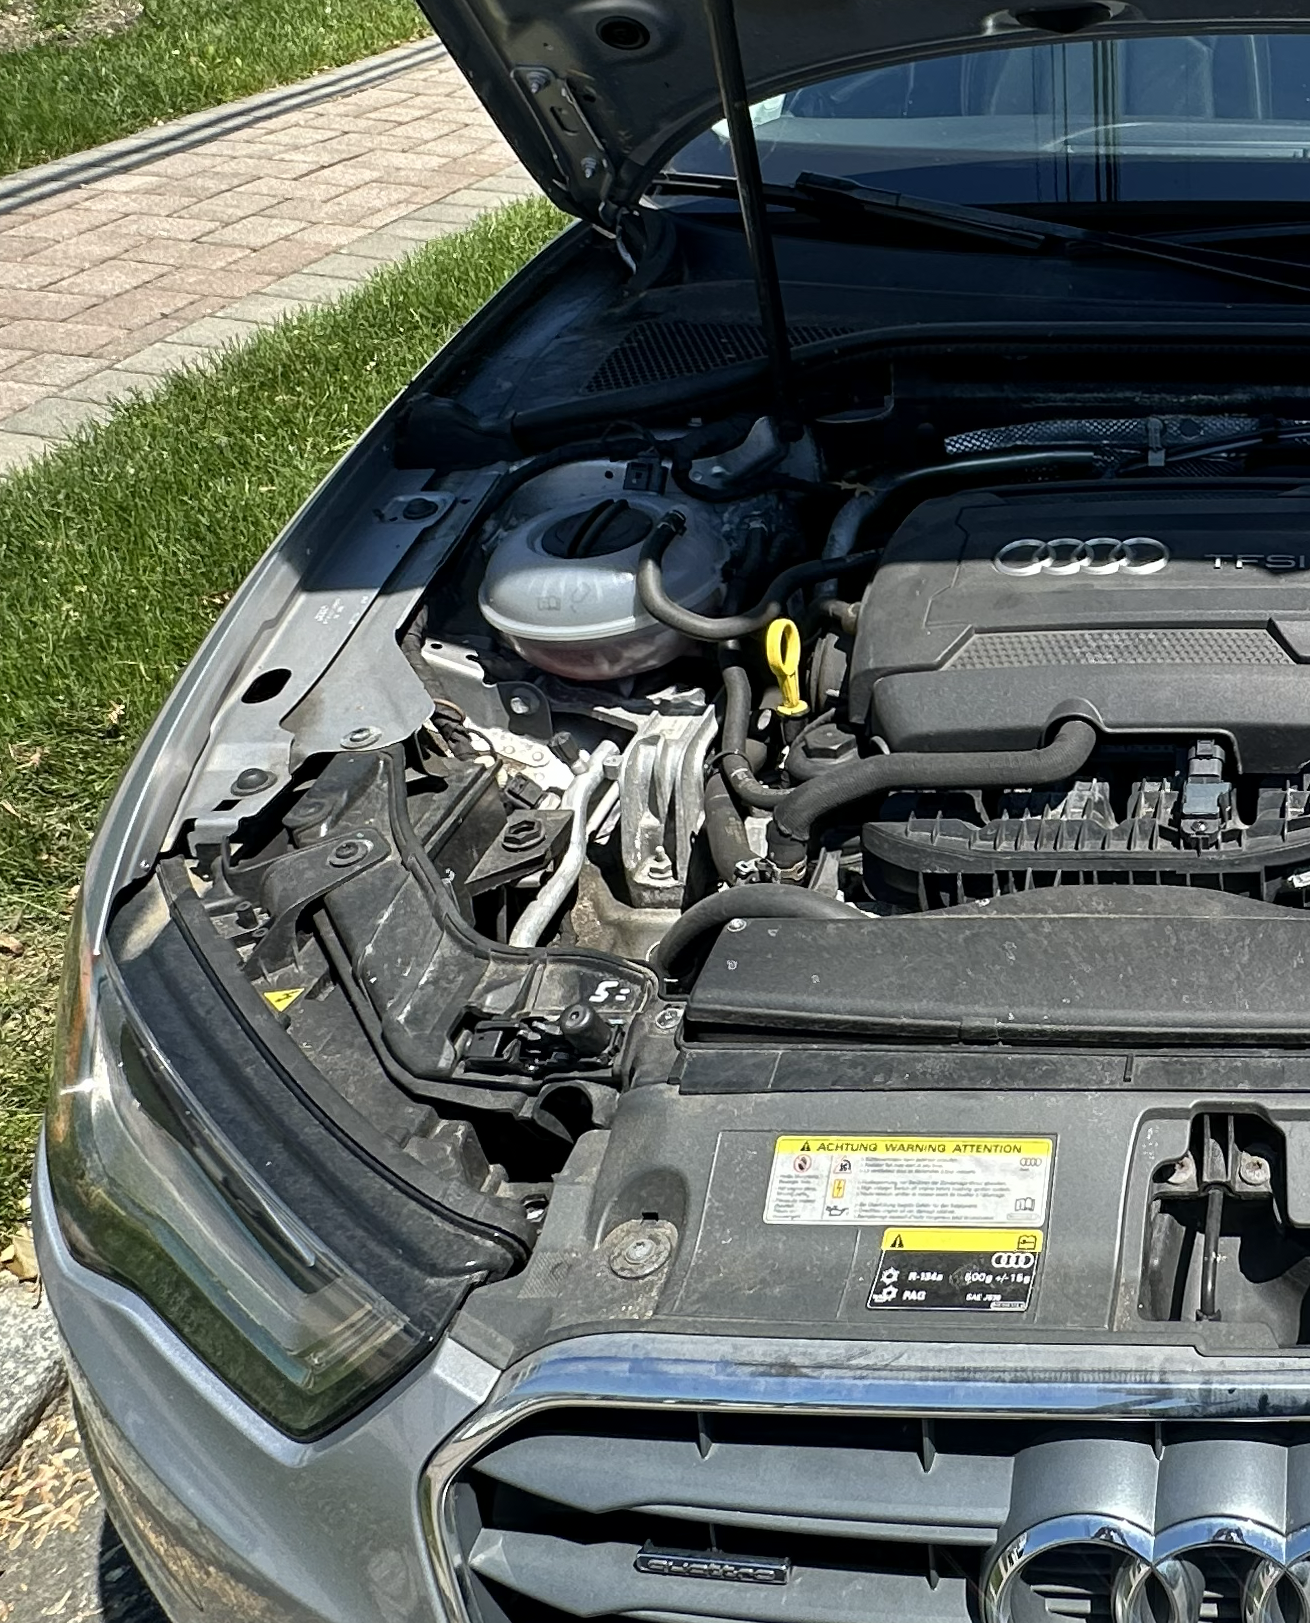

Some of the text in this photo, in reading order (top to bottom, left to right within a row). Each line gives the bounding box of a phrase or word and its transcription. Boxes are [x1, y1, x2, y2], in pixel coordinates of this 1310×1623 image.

[1204, 554, 1305, 569] TFSI
[816, 1142, 1023, 1154] ACHTUNG WARNING ATTENTION
